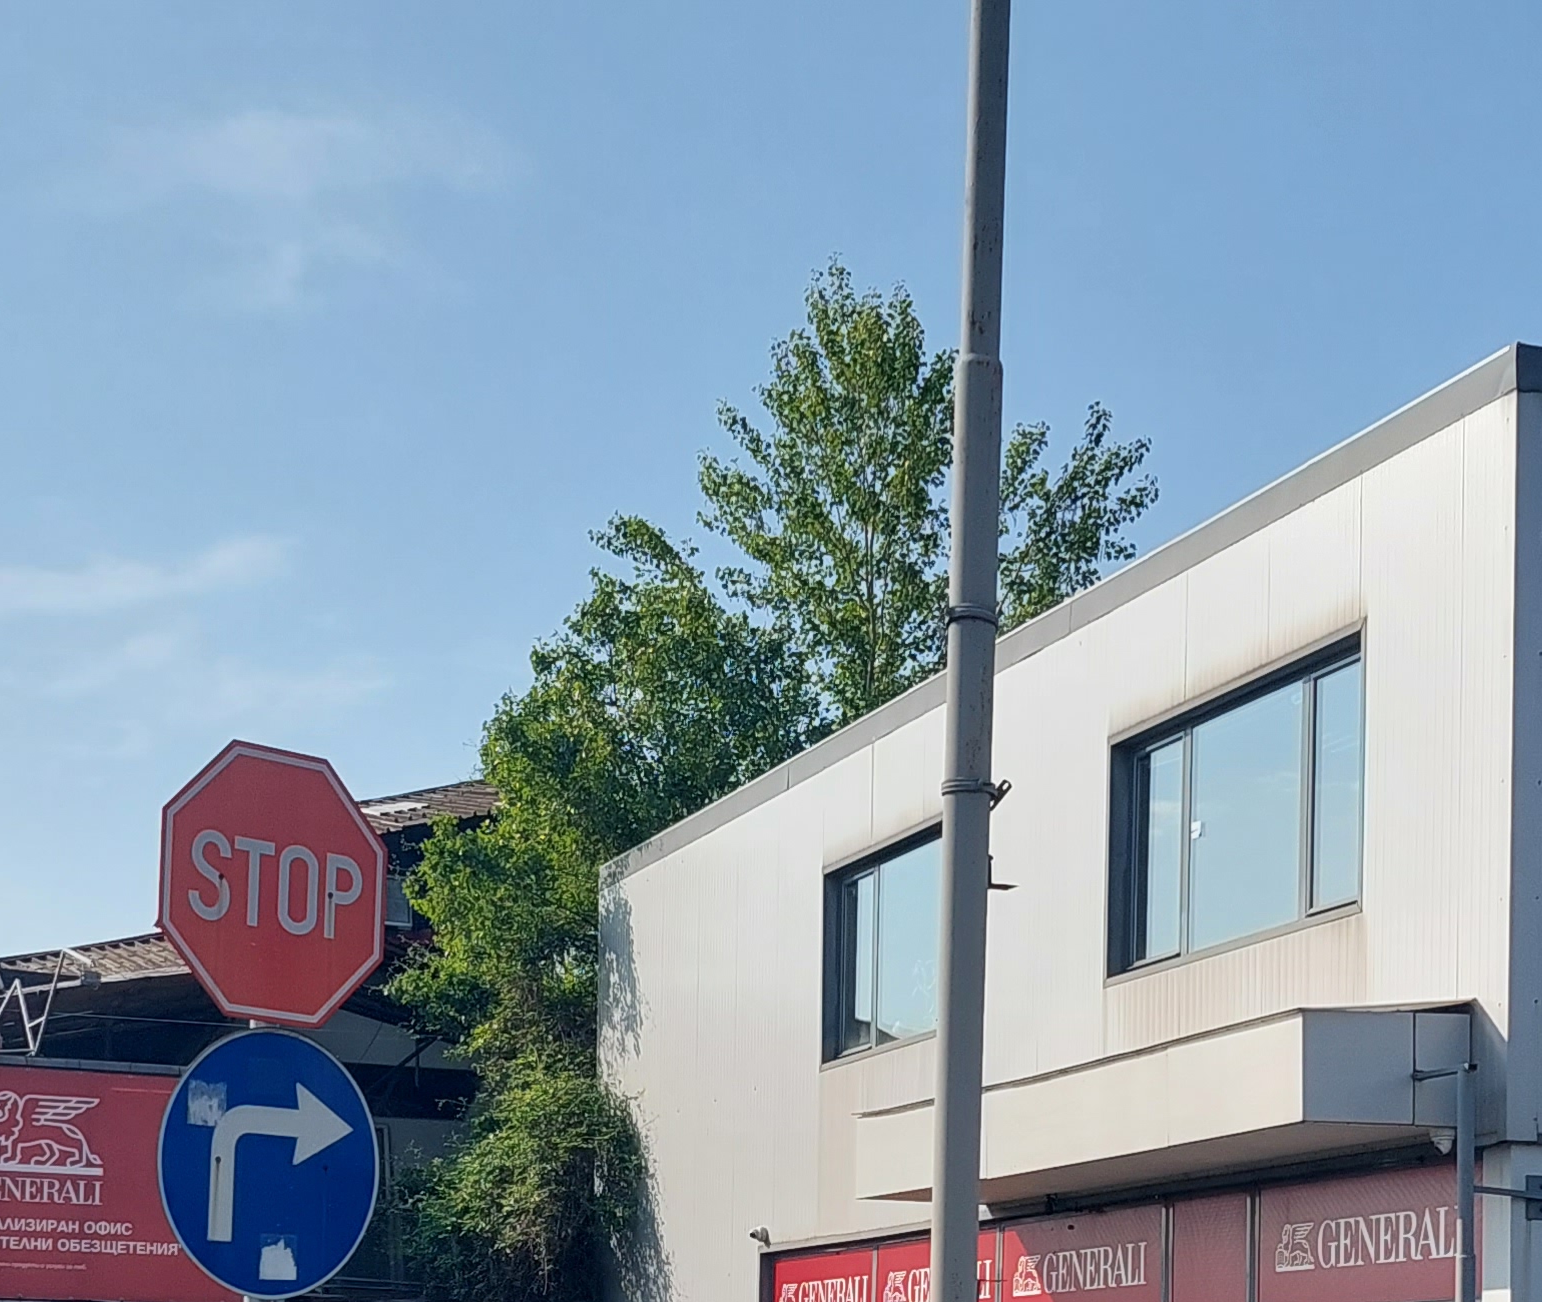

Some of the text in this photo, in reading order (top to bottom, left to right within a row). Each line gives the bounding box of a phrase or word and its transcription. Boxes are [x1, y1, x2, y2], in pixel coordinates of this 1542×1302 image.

[187, 829, 363, 939] STOP
[83, 1219, 133, 1236] ОФИС
[1042, 1242, 1148, 1294] GENERALI
